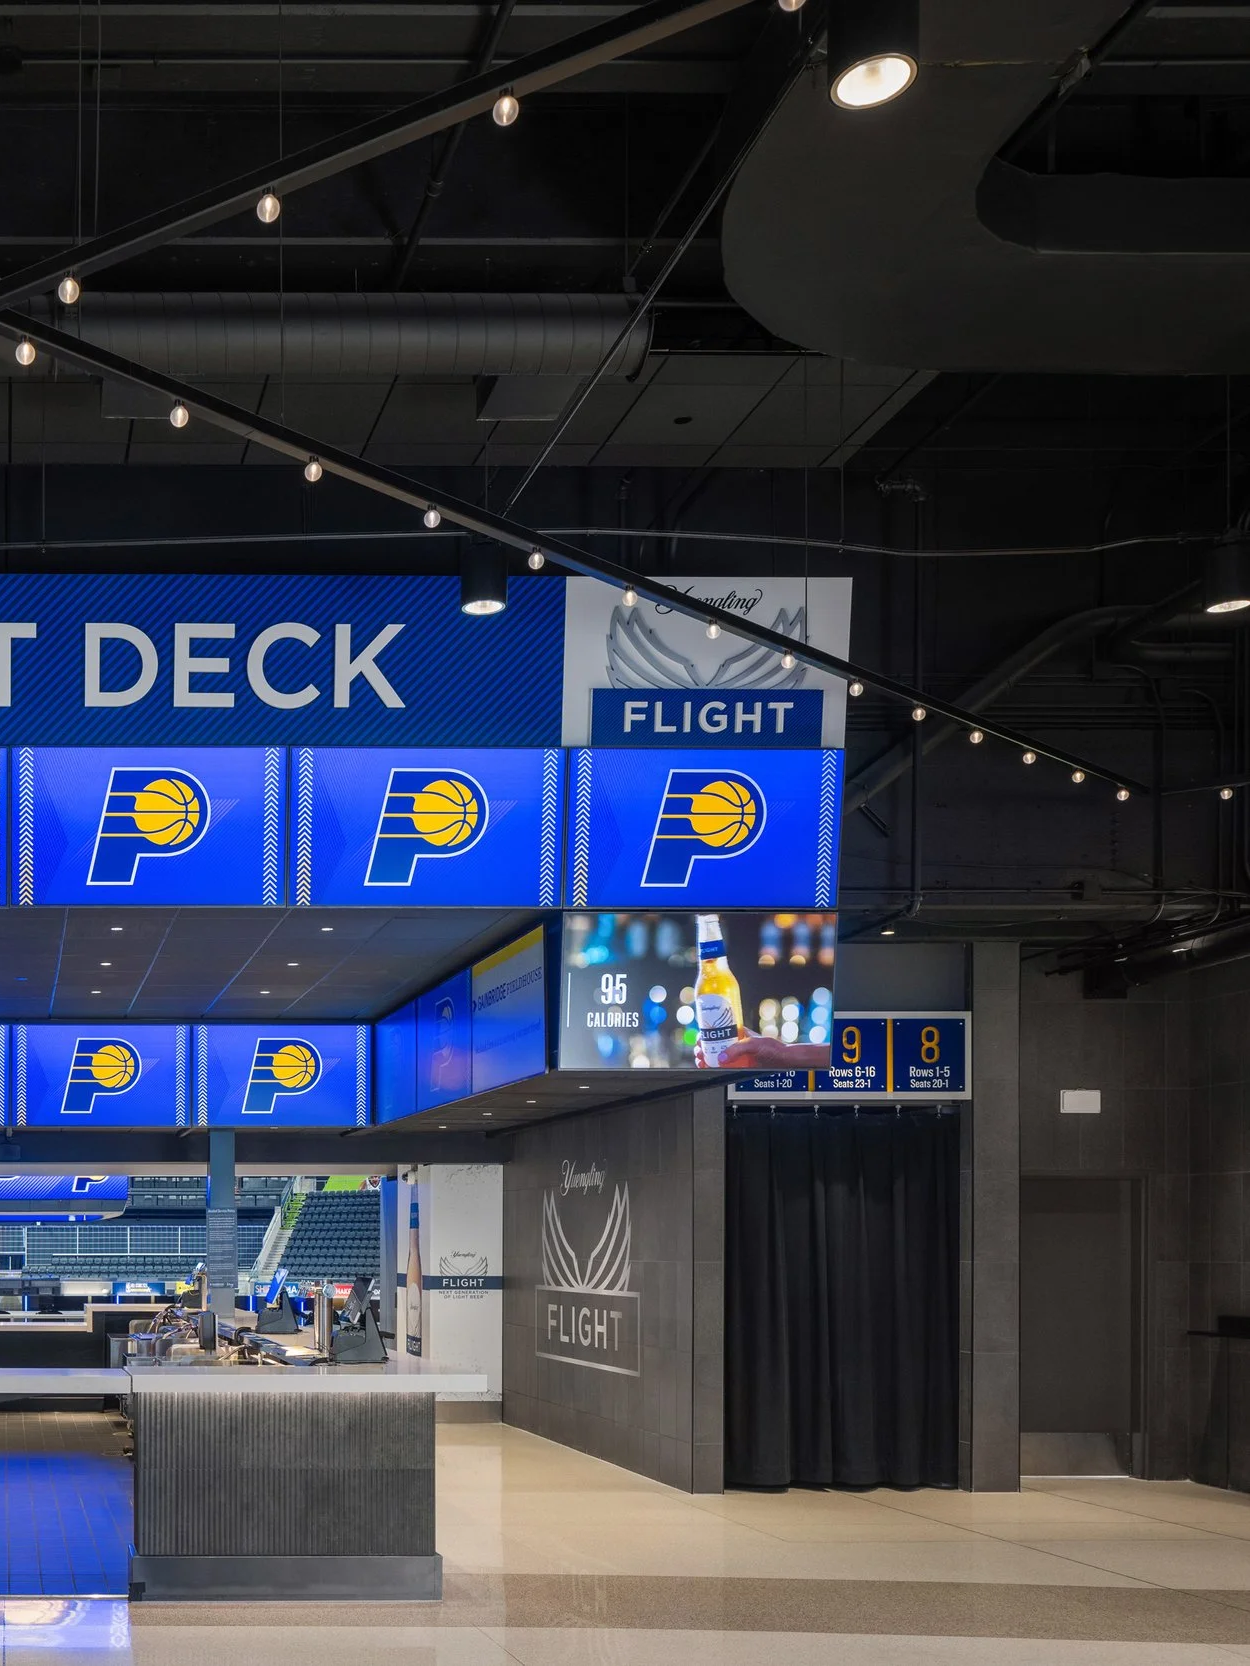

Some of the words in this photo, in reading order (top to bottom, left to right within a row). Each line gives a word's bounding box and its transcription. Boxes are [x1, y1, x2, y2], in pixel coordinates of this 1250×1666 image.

[83, 622, 407, 711] DECK
[623, 701, 794, 734] FLIGHT
[600, 973, 627, 1005] 95
[587, 1012, 639, 1028] CALORIES
[842, 1026, 861, 1063] 9
[921, 1026, 940, 1063] 8
[754, 1078, 775, 1088] Seats
[776, 1078, 792, 1088] 1-20
[829, 1066, 854, 1077] Rows
[855, 1066, 876, 1077] 6-16
[833, 1078, 854, 1088] Seats
[855, 1078, 871, 1088] 23-1
[909, 1066, 935, 1077] Rows
[936, 1066, 950, 1077] 1-5
[910, 1078, 931, 1088] Seats
[932, 1078, 949, 1088] 20-1
[560, 1159, 607, 1196] Yuengling
[442, 1278, 485, 1287] FLIGHT
[547, 1304, 623, 1351] FLIGHT
